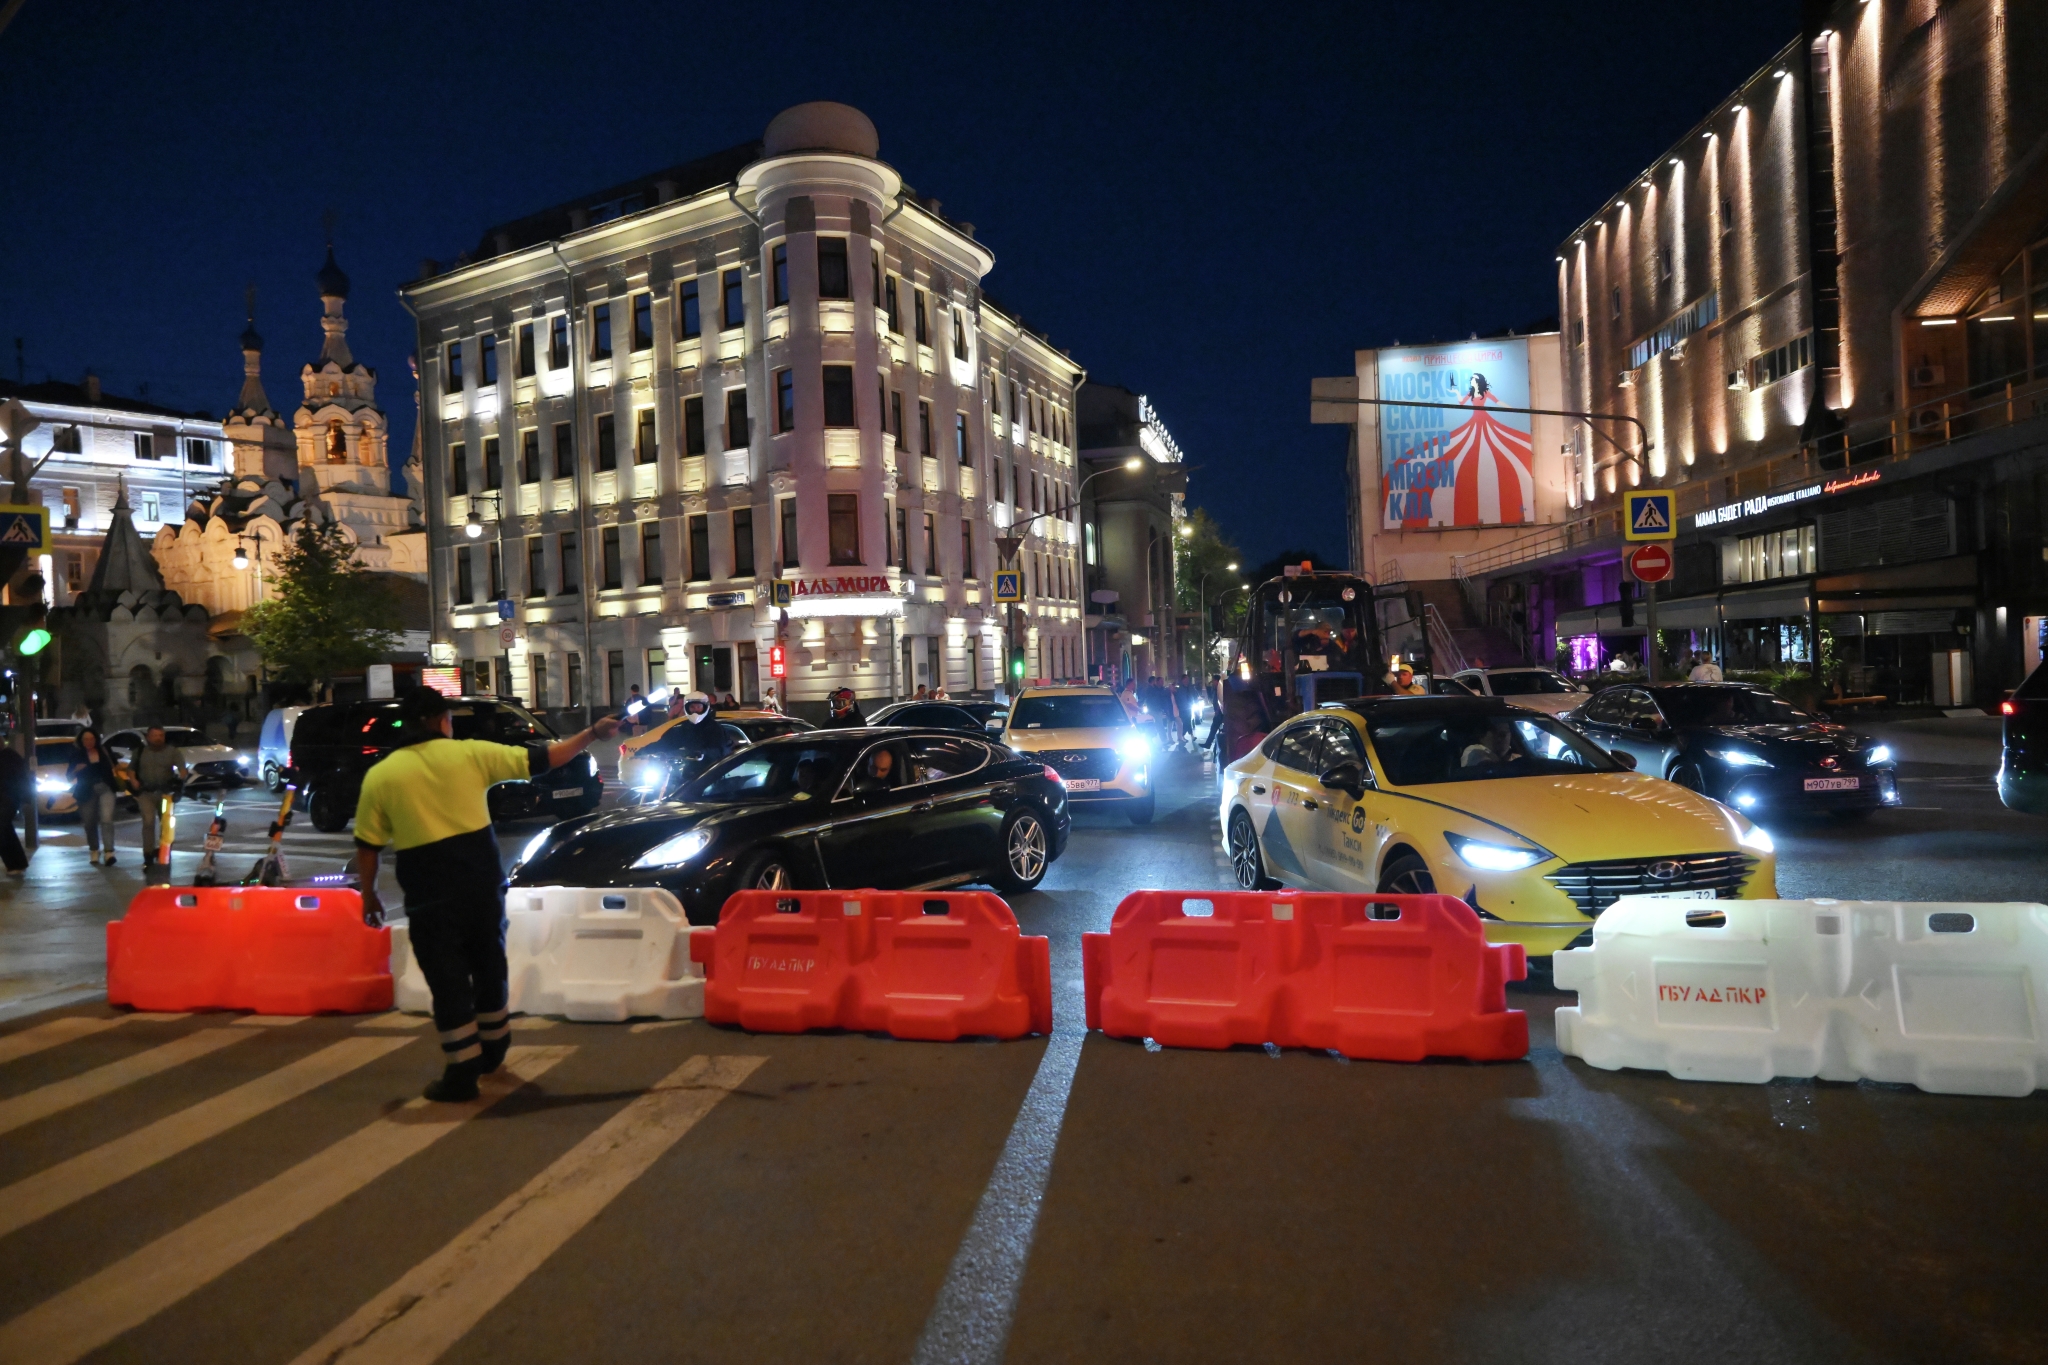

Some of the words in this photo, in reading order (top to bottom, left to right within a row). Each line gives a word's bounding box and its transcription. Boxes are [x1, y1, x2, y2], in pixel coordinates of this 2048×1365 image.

[1474, 350, 1503, 362] ЦИРКА
[1385, 369, 1472, 400] МОСКОВ
[1386, 398, 1444, 431] СКИЙ
[1387, 430, 1451, 460] ТЕАТР
[1388, 459, 1455, 490] МЮЗИ
[1389, 491, 1433, 521] КЛА
[1695, 509, 1717, 528] МАМА
[1718, 502, 1742, 523] БУДЕТ
[1744, 495, 1767, 516] РАДА
[1767, 491, 1795, 507] RISTORANTE
[1795, 485, 1821, 500] ITALIANO
[1353, 812, 1364, 830] Go
[1342, 831, 1362, 853] Такси
